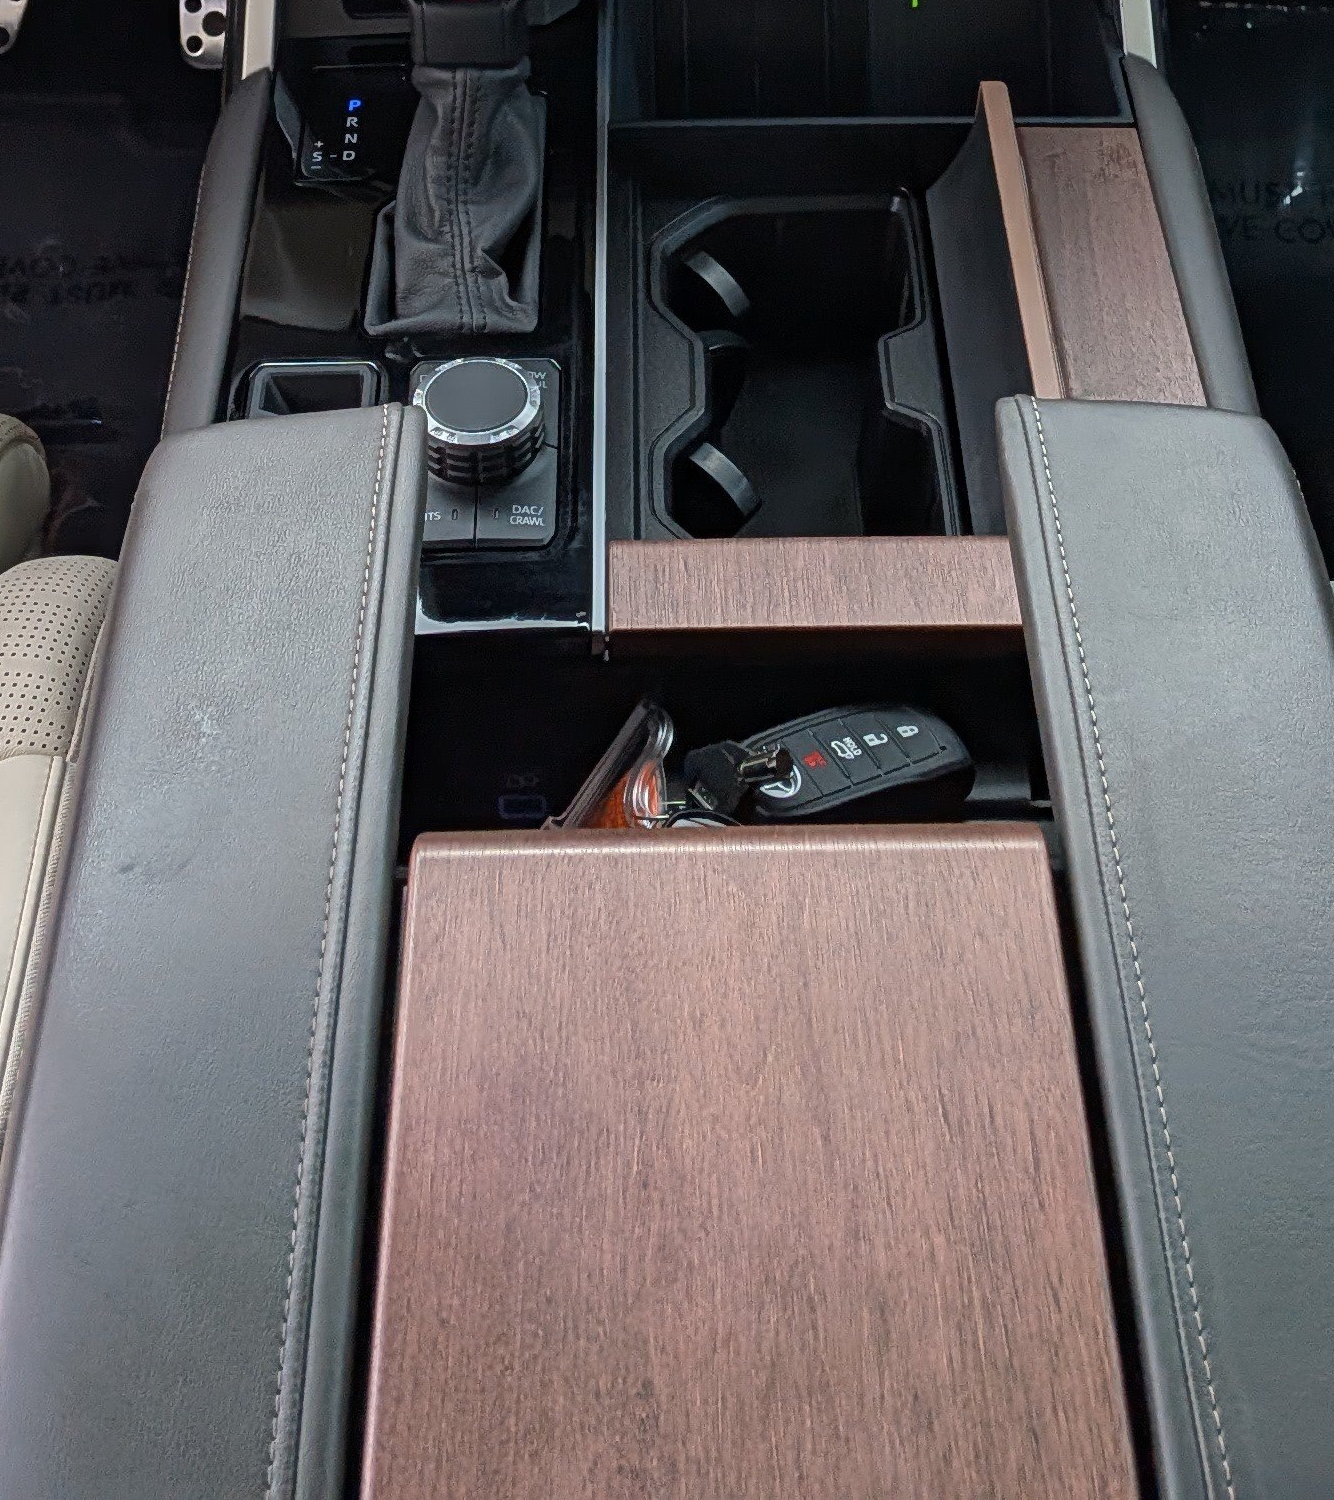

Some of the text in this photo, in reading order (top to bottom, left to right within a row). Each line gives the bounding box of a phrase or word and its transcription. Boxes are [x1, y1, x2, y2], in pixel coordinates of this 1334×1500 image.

[348, 99, 362, 111] P
[346, 116, 359, 128] R
[344, 133, 358, 144] N
[312, 151, 323, 162] S
[342, 150, 356, 161] D
[512, 504, 544, 515] DAC/
[509, 515, 545, 527] CRAWL
